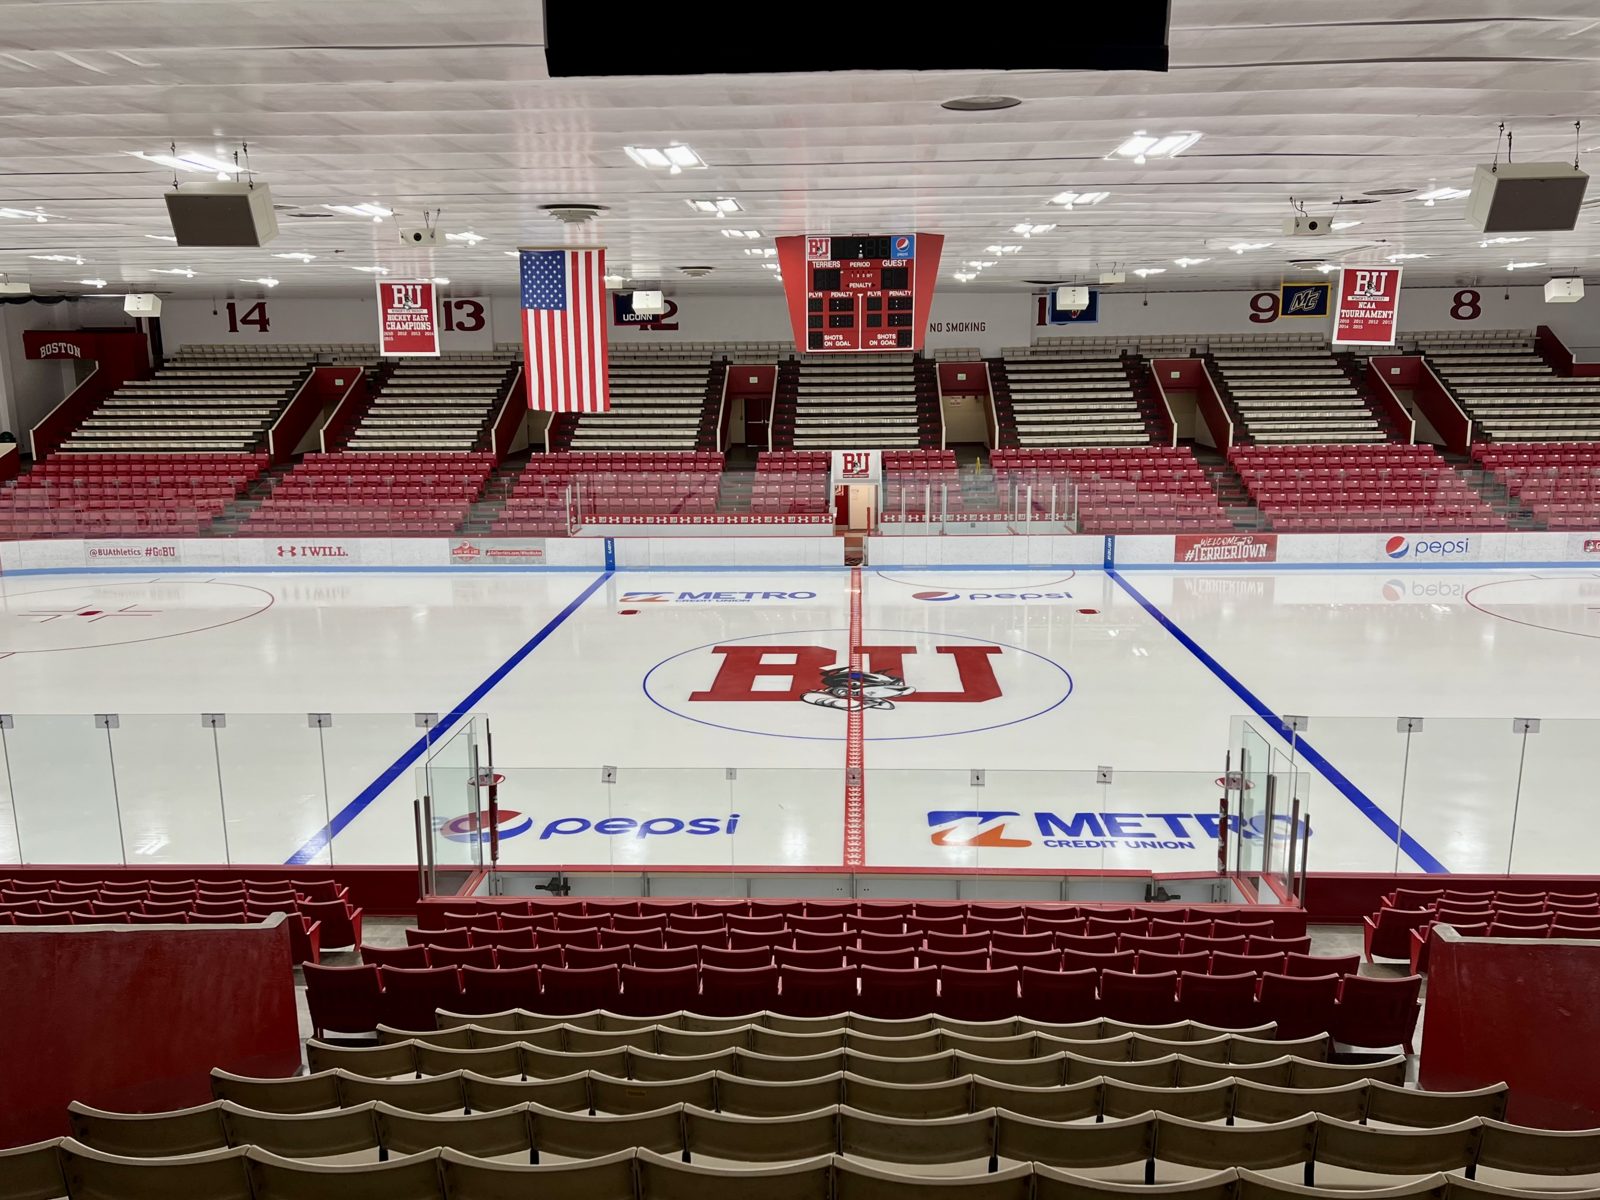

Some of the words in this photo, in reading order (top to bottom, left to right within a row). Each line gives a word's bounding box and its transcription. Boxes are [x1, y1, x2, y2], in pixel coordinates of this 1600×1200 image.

[808, 239, 829, 256] BU
[882, 259, 907, 267] GUEST
[1354, 271, 1388, 295] BU
[391, 285, 422, 308] BU
[1450, 289, 1482, 320] 8
[1249, 292, 1280, 323] 9
[1341, 309, 1394, 319] TOURNAMENT
[226, 301, 270, 333] 14
[387, 314, 411, 322] HOCKEY
[443, 300, 486, 332] 13
[622, 313, 653, 321] UCONN
[385, 321, 432, 331] CHAMPIONS
[929, 322, 943, 333] NO
[946, 321, 986, 332] SMOKING
[40, 342, 81, 358] BOSTON
[842, 453, 870, 473] BU
[1200, 536, 1240, 546] WELCOME
[1415, 538, 1469, 557] pepsi
[89, 548, 141, 558] @BUAthletics
[678, 591, 817, 600] METRO
[969, 591, 1073, 602] pepsi
[688, 645, 1003, 702] BU
[539, 813, 741, 840] pepsi
[1034, 811, 1313, 841] METRO
[1043, 839, 1116, 848] CREDIT
[1125, 840, 1196, 850] UNION
